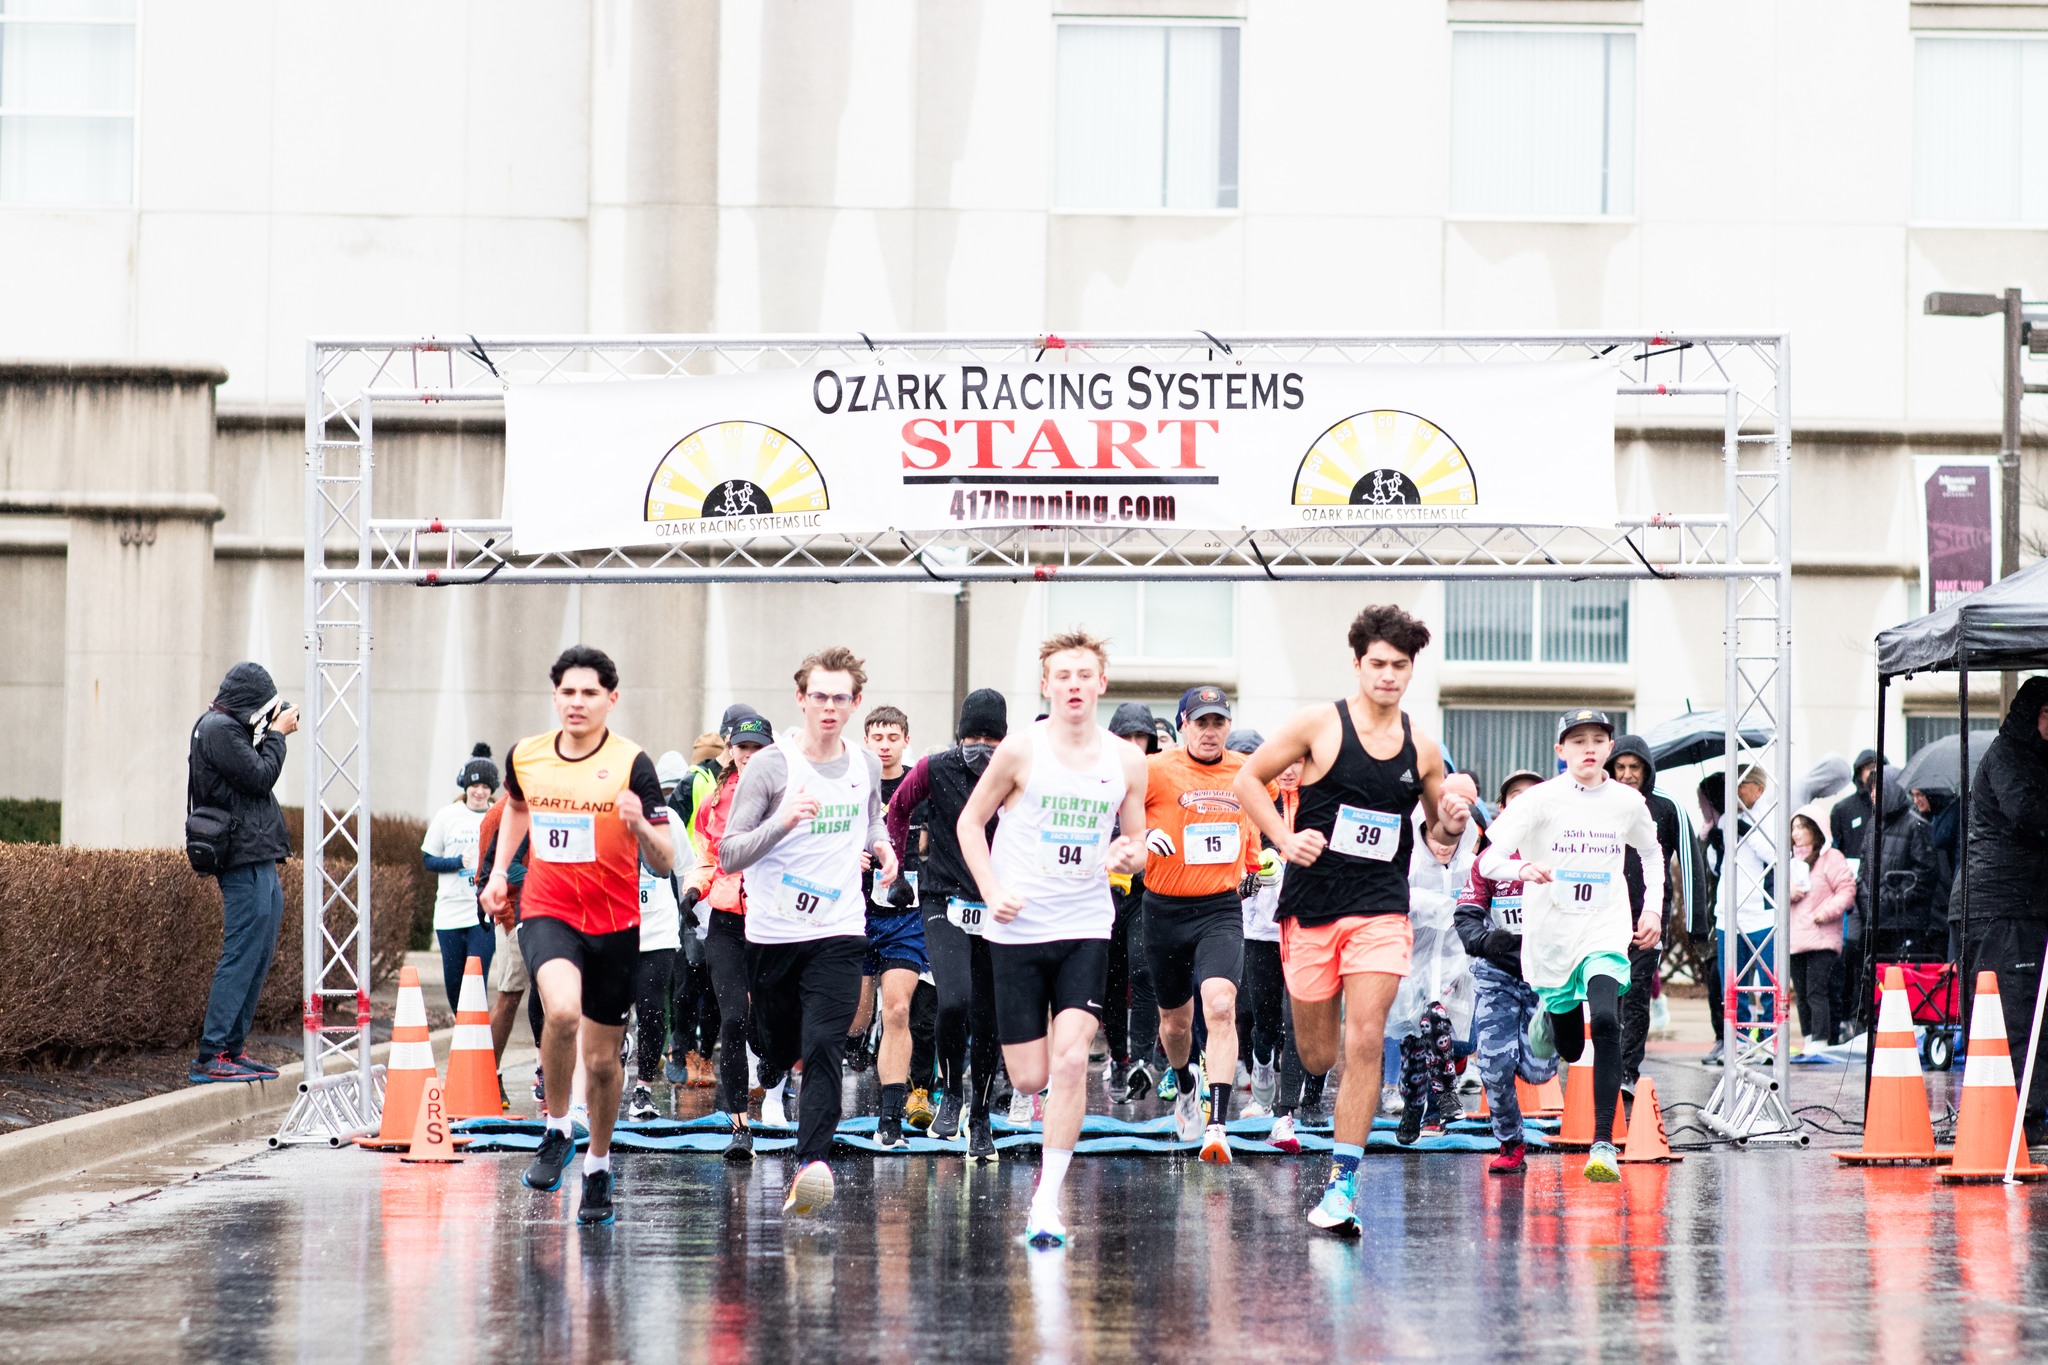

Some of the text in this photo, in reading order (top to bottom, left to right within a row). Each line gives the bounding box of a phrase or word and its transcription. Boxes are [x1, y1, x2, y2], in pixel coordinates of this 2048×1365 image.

[813, 365, 1304, 414] OZARK RACING SYSTEMS
[901, 418, 1220, 470] START
[950, 490, 1176, 523] 417Running.com
[1302, 508, 1469, 521] OZARK RACING SYSTEMS LLC
[655, 514, 822, 537] OZARK RACING SYSTEMS LLC
[1935, 580, 1985, 592] MAKE YOUR
[527, 796, 614, 813] HEARTLAND
[816, 803, 860, 819] GHTIN
[1052, 812, 1098, 829] IRISH
[1352, 811, 1394, 824] JACK FROST
[810, 820, 851, 834] IRISH
[1356, 825, 1382, 846] 39
[1563, 830, 1616, 839] 35th Annual
[549, 829, 569, 848] 87
[1204, 836, 1222, 852] 15
[1058, 845, 1082, 865] 94
[1552, 843, 1577, 853] Jack
[1581, 843, 1608, 854] Frost
[1573, 883, 1593, 901] 10
[795, 892, 820, 914] 97
[962, 909, 981, 924] 80
